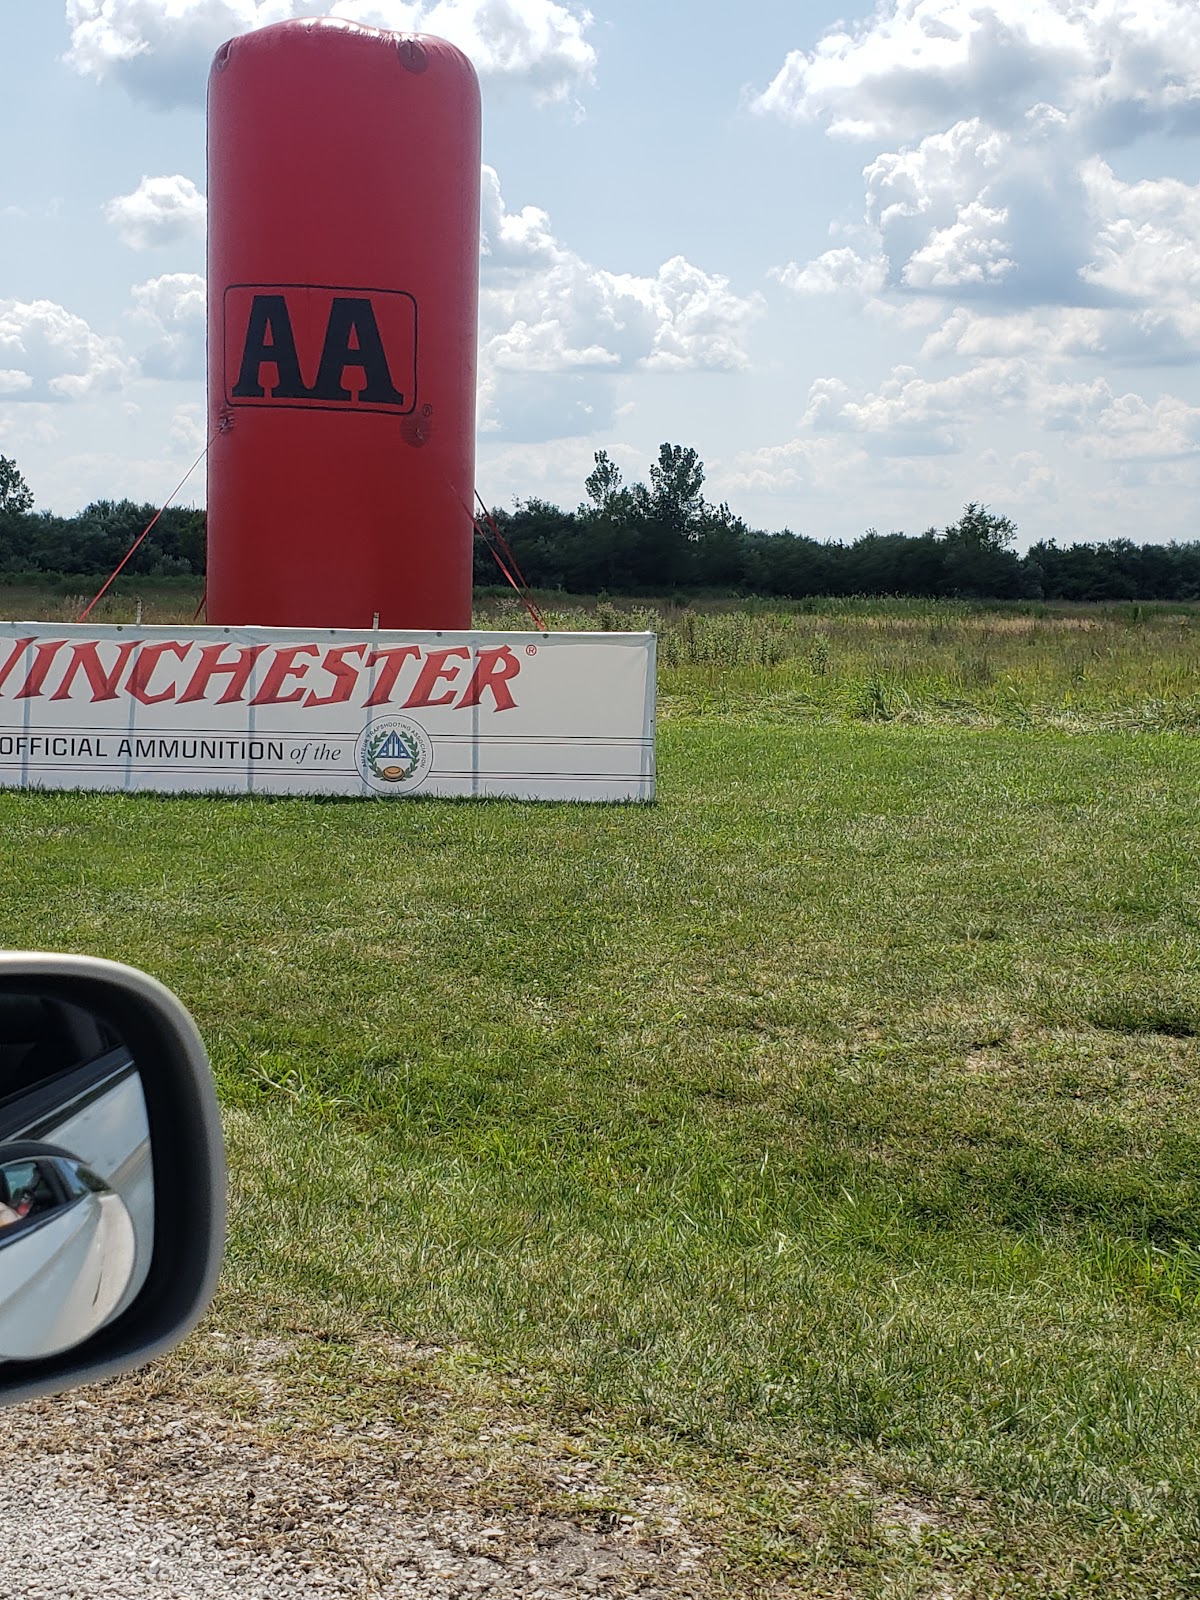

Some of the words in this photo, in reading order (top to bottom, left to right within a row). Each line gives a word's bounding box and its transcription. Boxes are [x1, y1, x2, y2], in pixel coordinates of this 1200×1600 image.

[232, 295, 404, 405] AA
[0, 737, 108, 757] OFFICIAL
[117, 740, 283, 760] AMMUNITION
[290, 743, 313, 764] of
[314, 744, 342, 761] the
